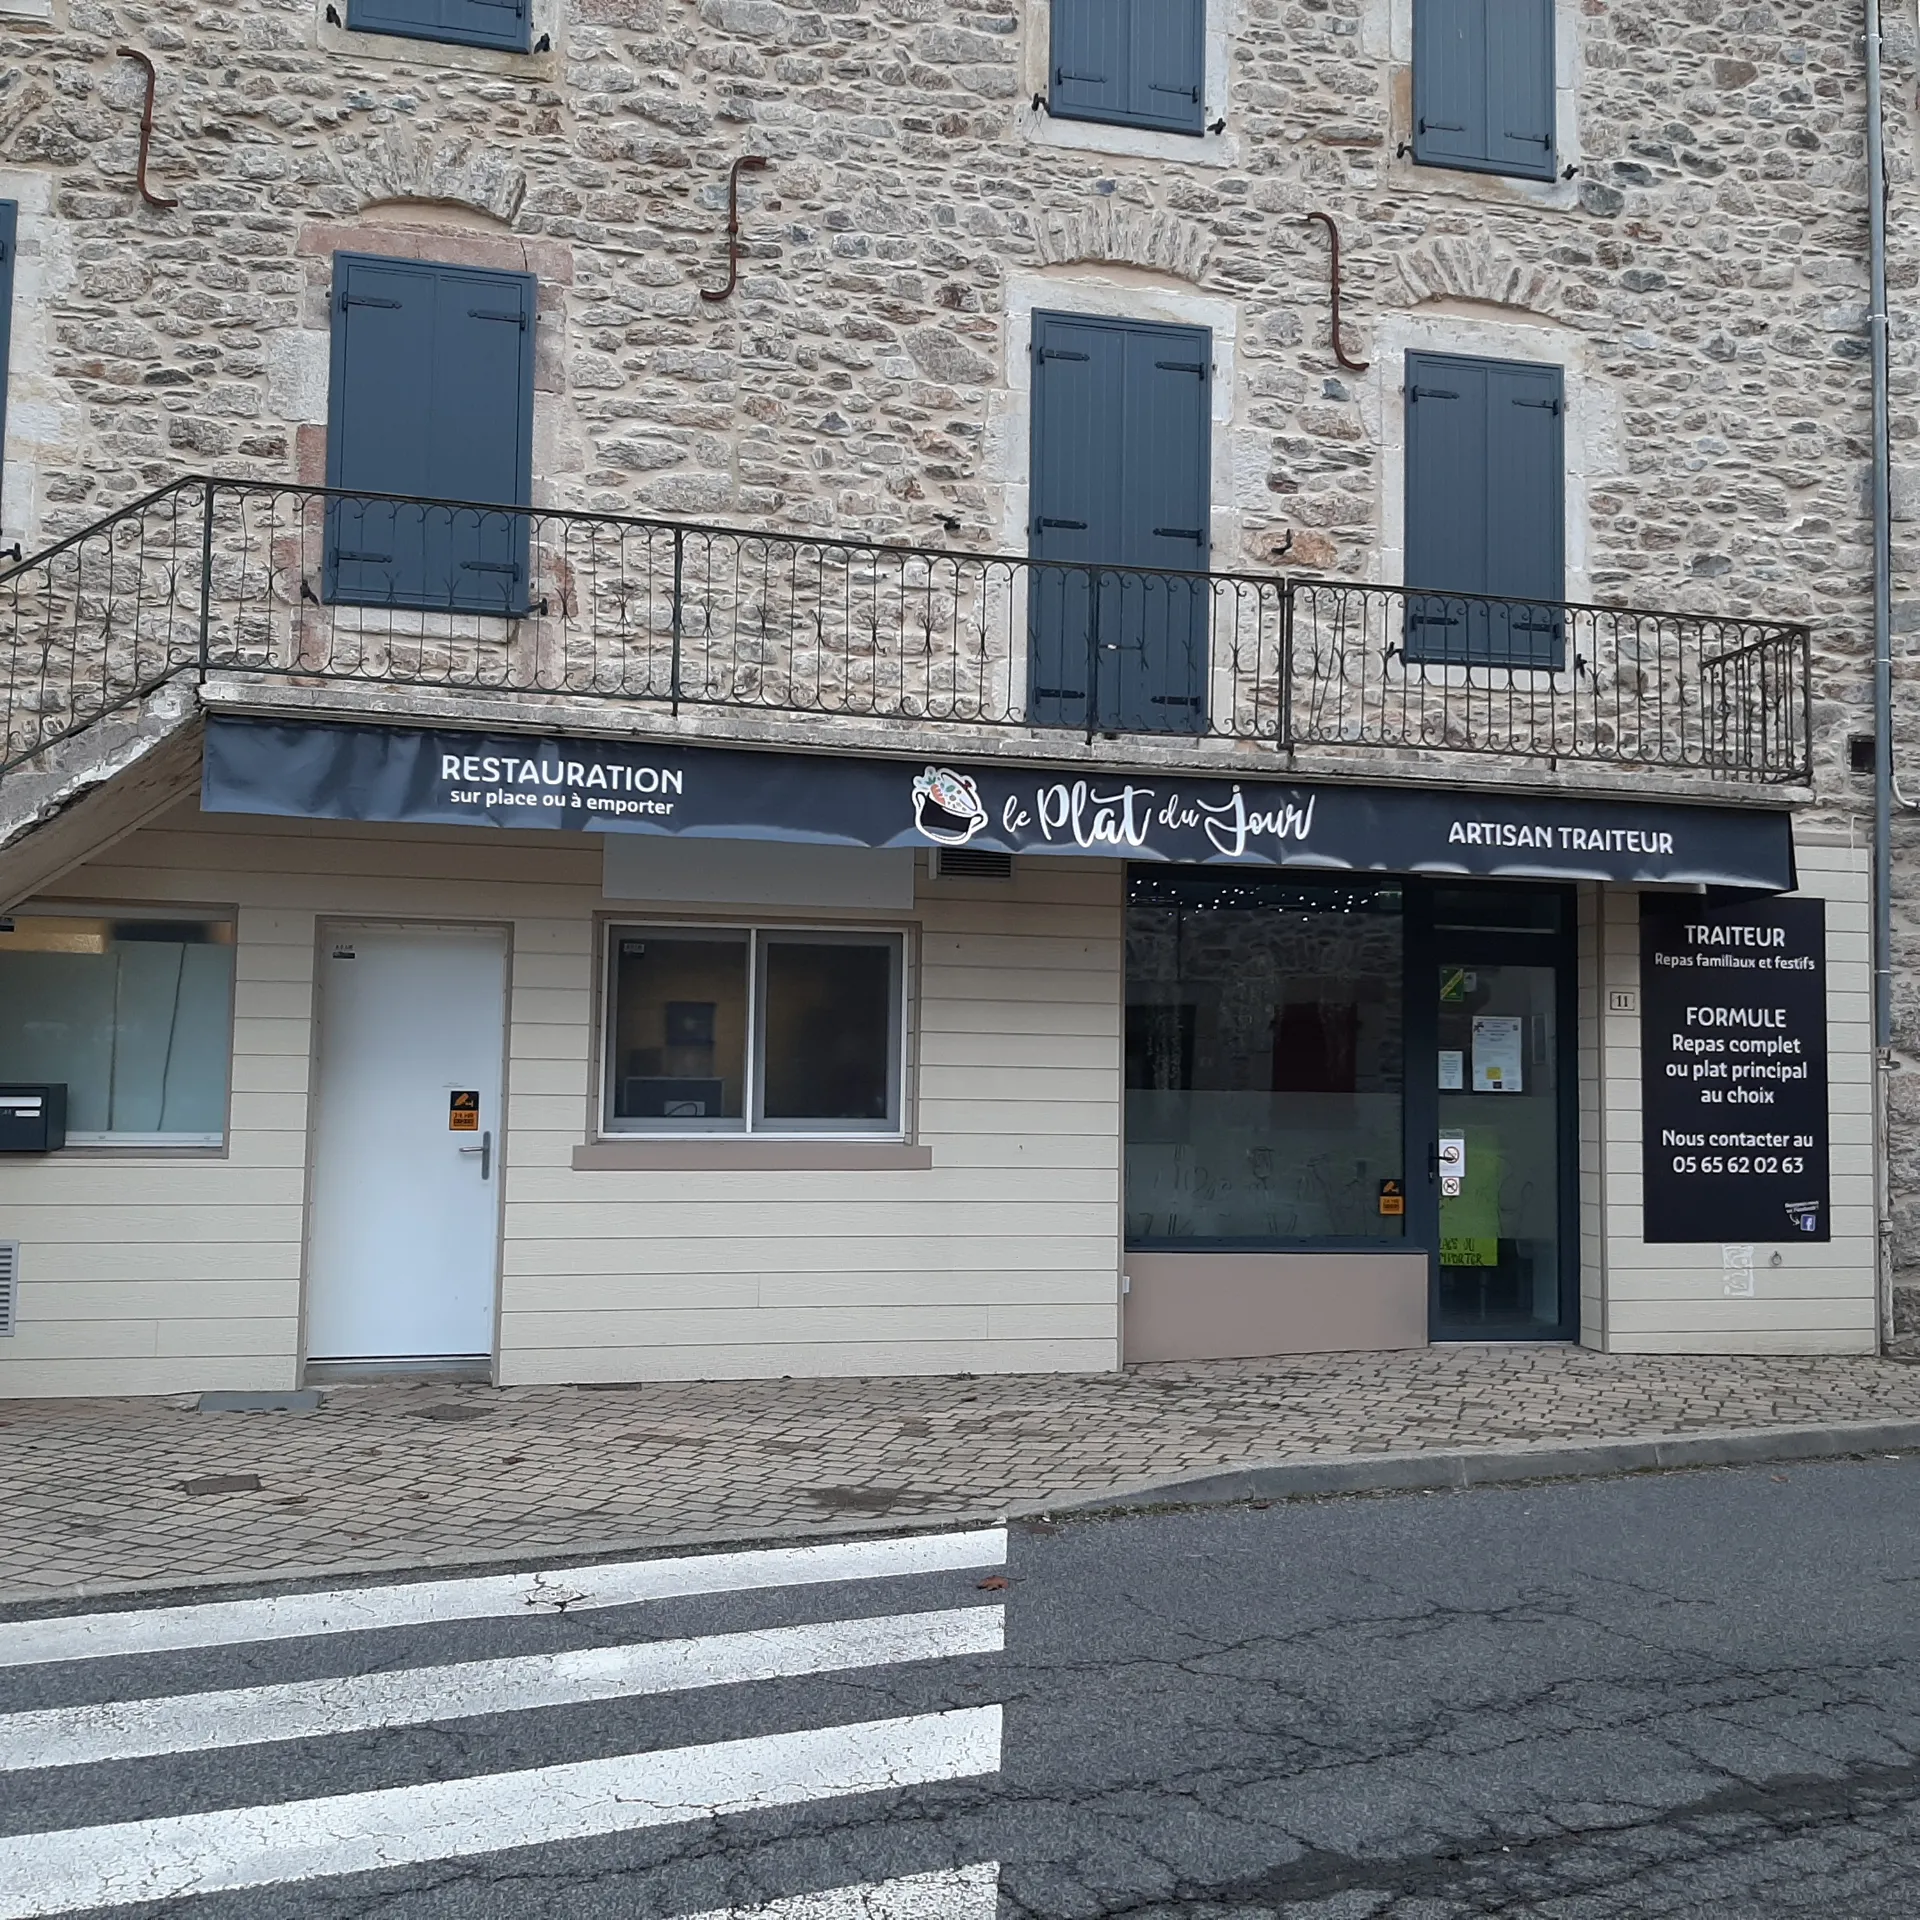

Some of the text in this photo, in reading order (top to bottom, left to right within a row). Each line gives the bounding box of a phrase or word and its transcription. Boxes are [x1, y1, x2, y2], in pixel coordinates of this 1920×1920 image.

[441, 755, 683, 795] RESTAURATION
[450, 788, 674, 815] sur place ou à emporter
[1003, 796, 1031, 833] le
[1037, 780, 1155, 848] Plat
[1158, 794, 1199, 829] du
[1448, 821, 1674, 854] ARTISAN TRAITEUR
[1684, 925, 1786, 947] TRAITEUR
[1655, 952, 1815, 970] Repas familiaux et festifs
[1686, 1006, 1787, 1028] FORMULE
[1672, 1034, 1801, 1057] Repas complet
[1665, 1060, 1807, 1082] ou plat principal
[1701, 1086, 1774, 1104] au choix
[1662, 1130, 1813, 1147] Nous contacter au
[1672, 1156, 1804, 1173] 05 65 62 02 63
